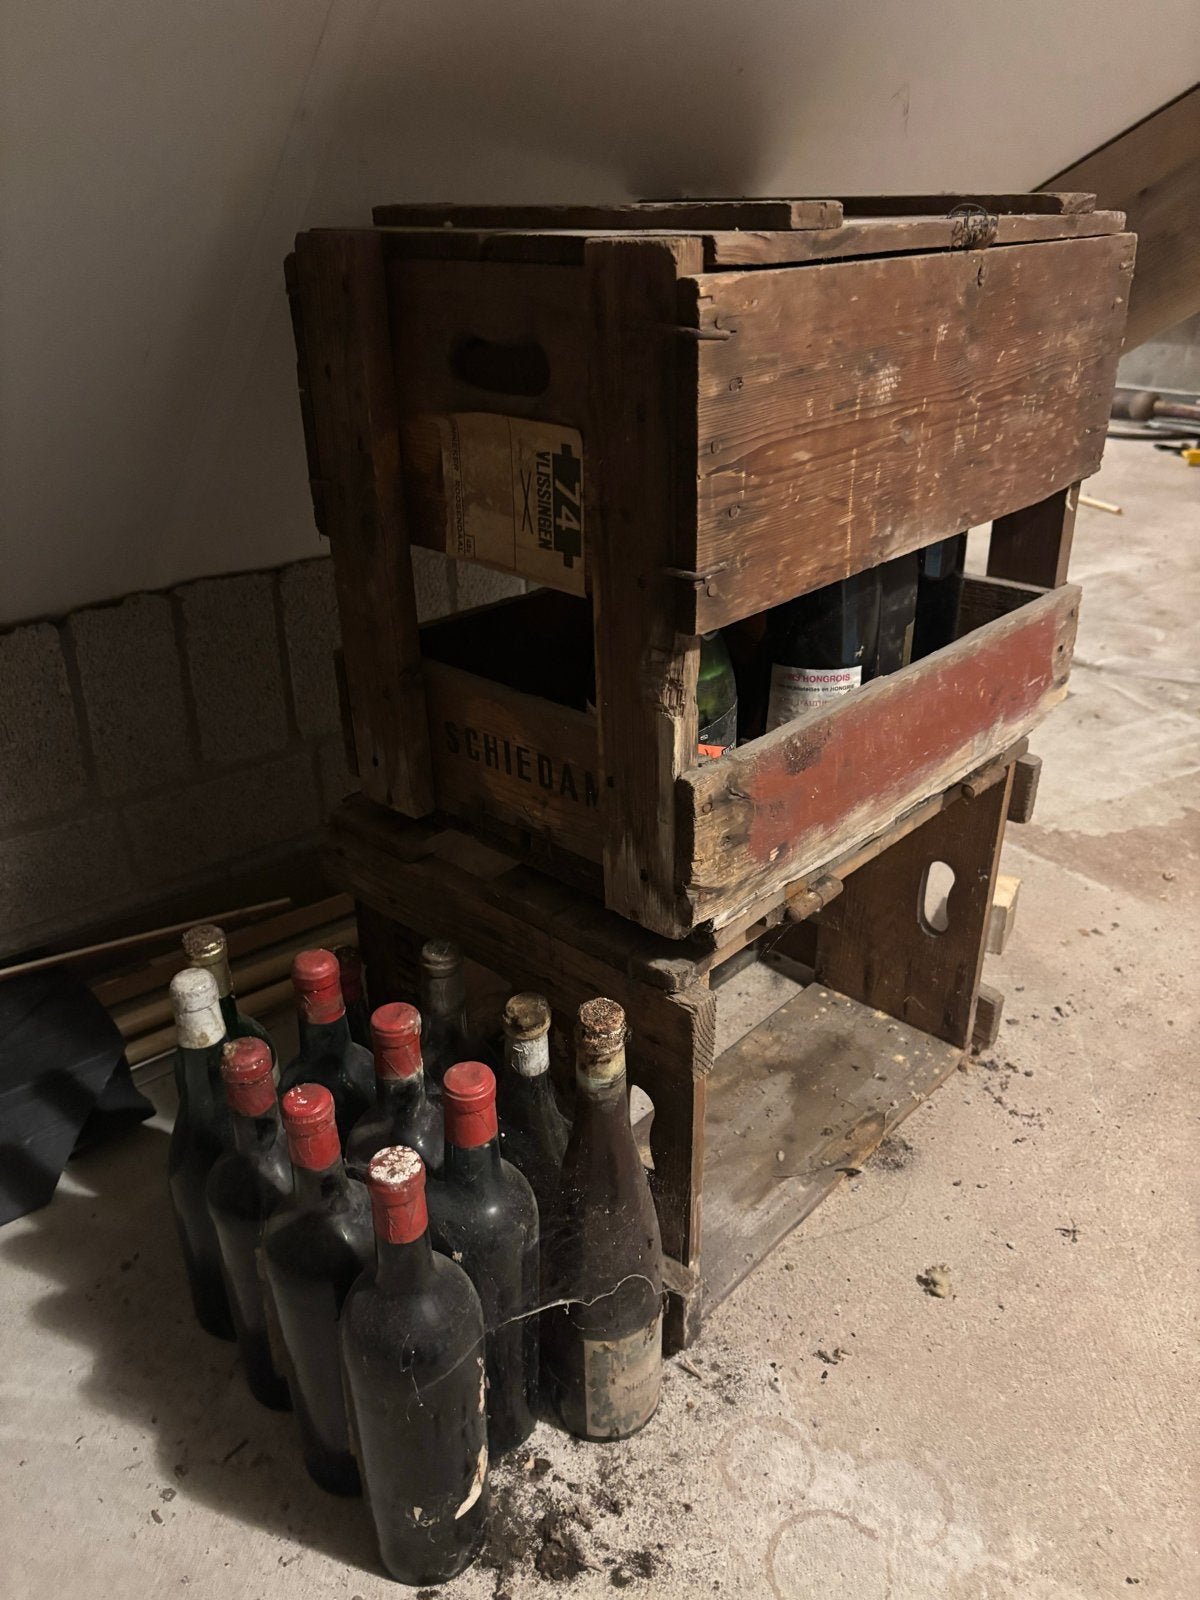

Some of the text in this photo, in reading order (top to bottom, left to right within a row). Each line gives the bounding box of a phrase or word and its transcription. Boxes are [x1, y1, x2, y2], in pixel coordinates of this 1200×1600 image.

[536, 451, 552, 550] VLISSINGEN
[554, 478, 581, 531] 74
[802, 673, 851, 683] HONGROIS
